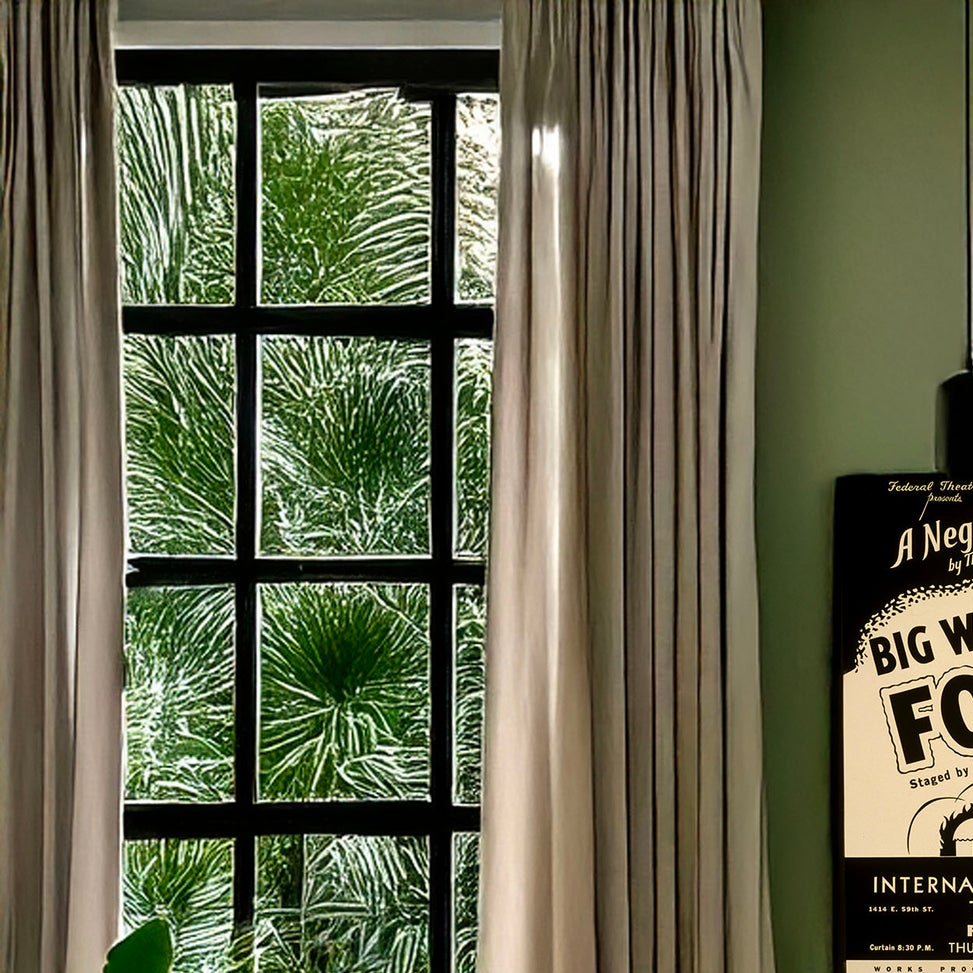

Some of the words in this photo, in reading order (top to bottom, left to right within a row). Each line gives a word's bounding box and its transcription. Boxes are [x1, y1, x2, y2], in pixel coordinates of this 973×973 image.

[887, 480, 934, 492] Federal
[890, 527, 914, 568] A
[948, 557, 962, 576] by
[868, 625, 935, 676] BIG
[909, 769, 951, 789] Staged
[955, 767, 969, 778] by
[869, 943, 895, 951] Curtain
